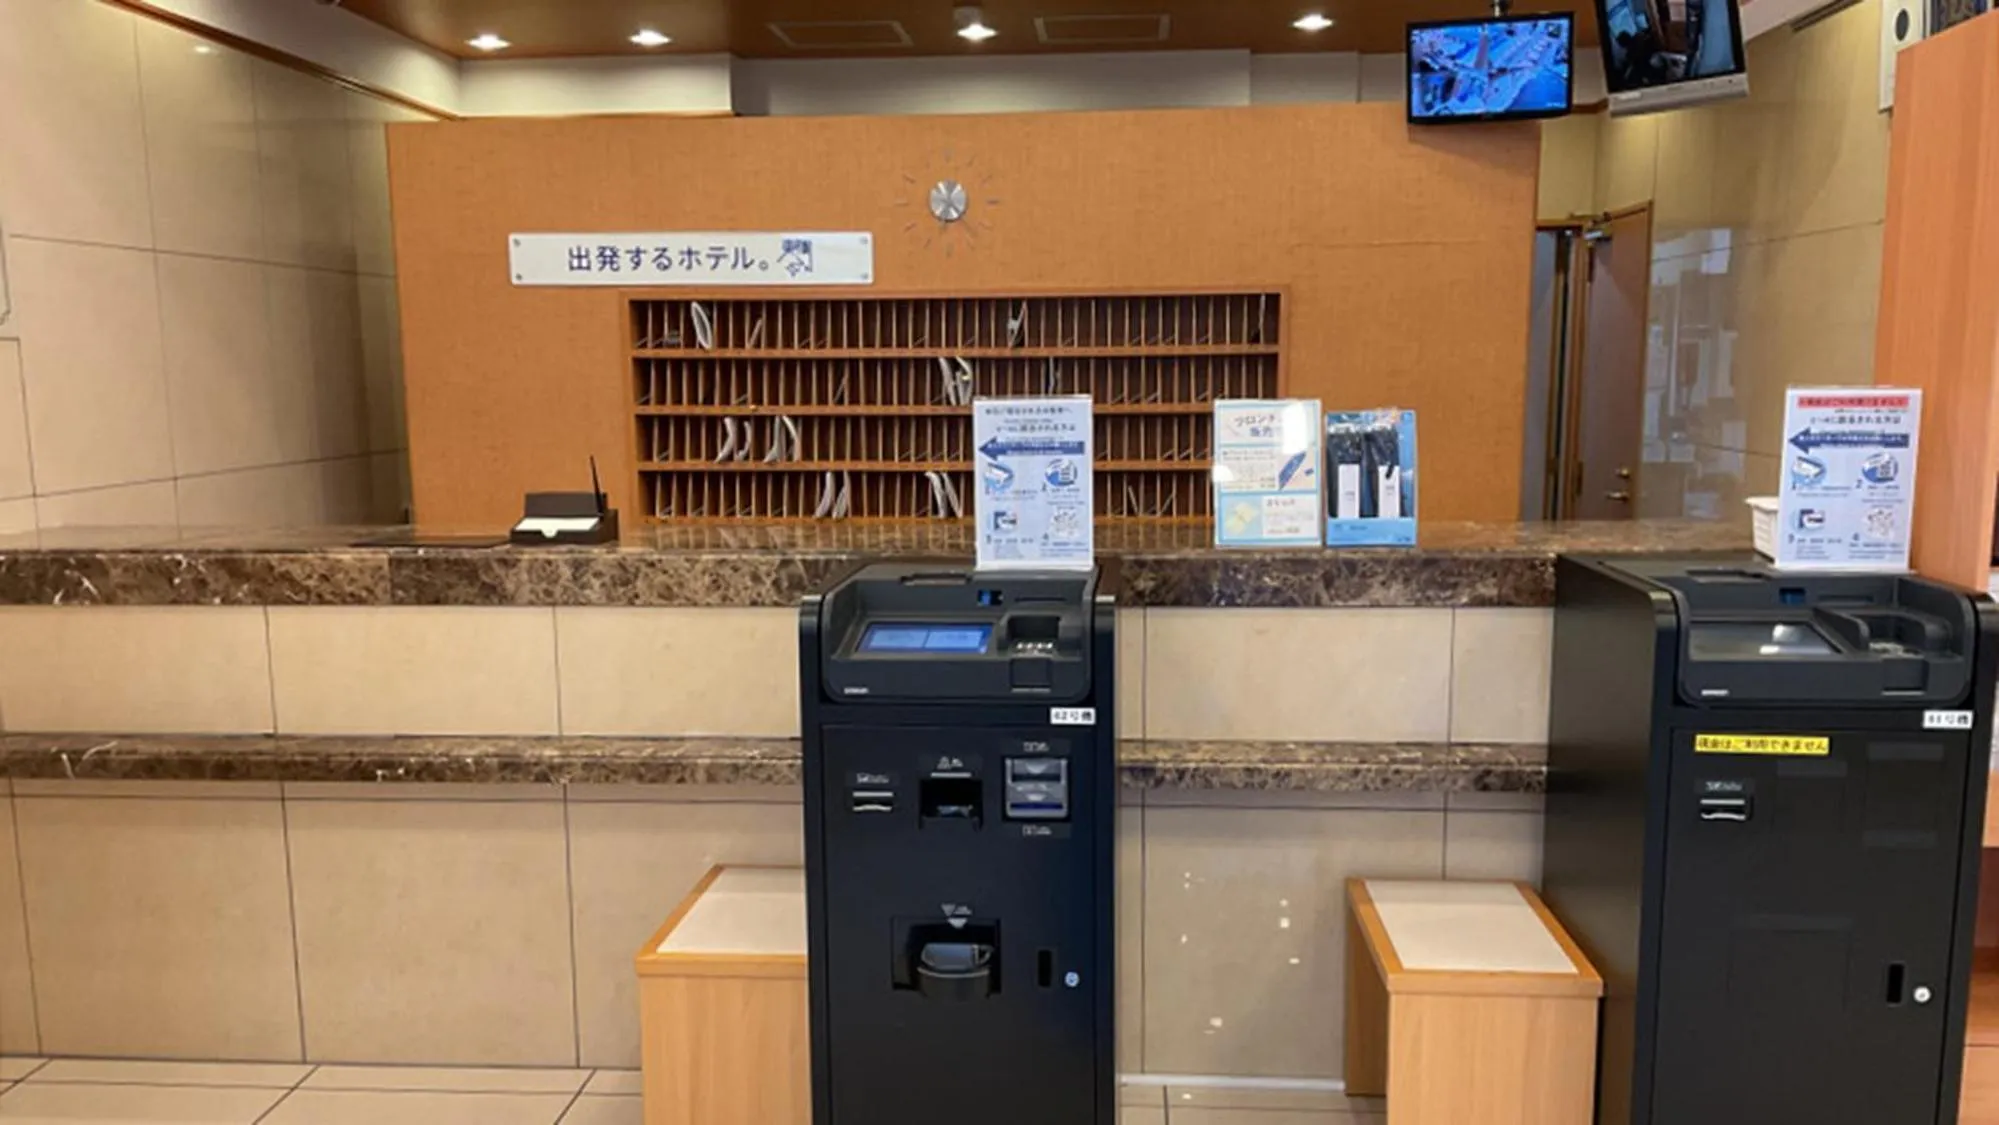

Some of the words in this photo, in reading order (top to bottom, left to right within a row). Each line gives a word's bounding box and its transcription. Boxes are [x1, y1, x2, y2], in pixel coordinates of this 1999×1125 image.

[568, 245, 769, 273] 出発するホテル。
